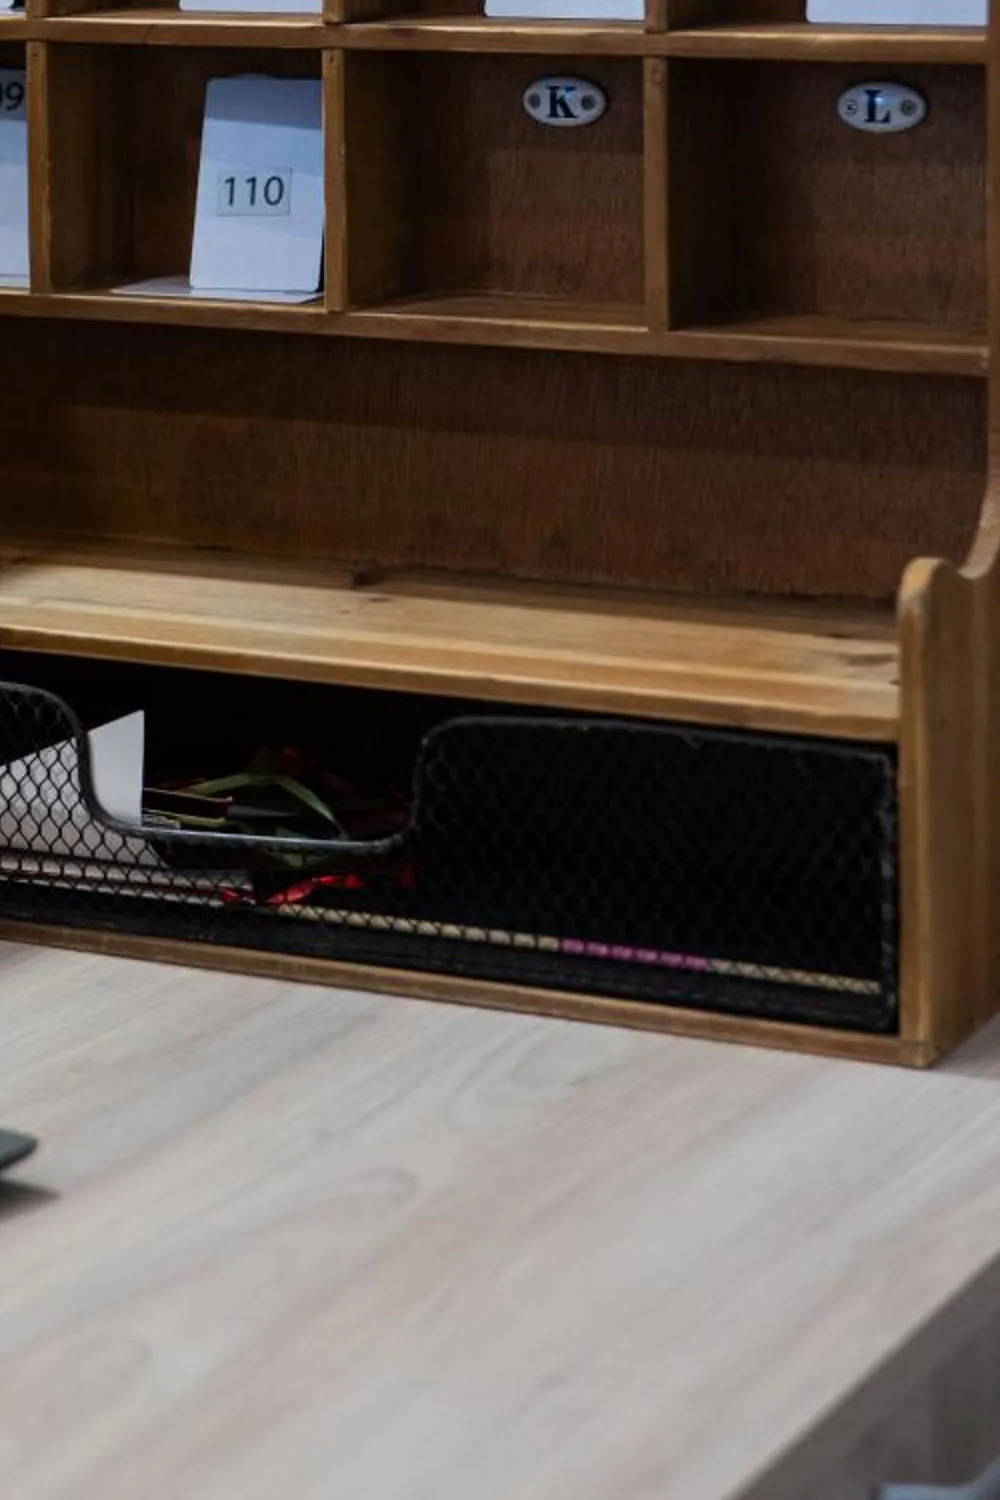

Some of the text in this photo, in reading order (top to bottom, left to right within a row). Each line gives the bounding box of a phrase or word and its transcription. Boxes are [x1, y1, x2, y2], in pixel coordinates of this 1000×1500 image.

[545, 84, 578, 120] K
[863, 88, 891, 124] L
[223, 175, 285, 207] 110
